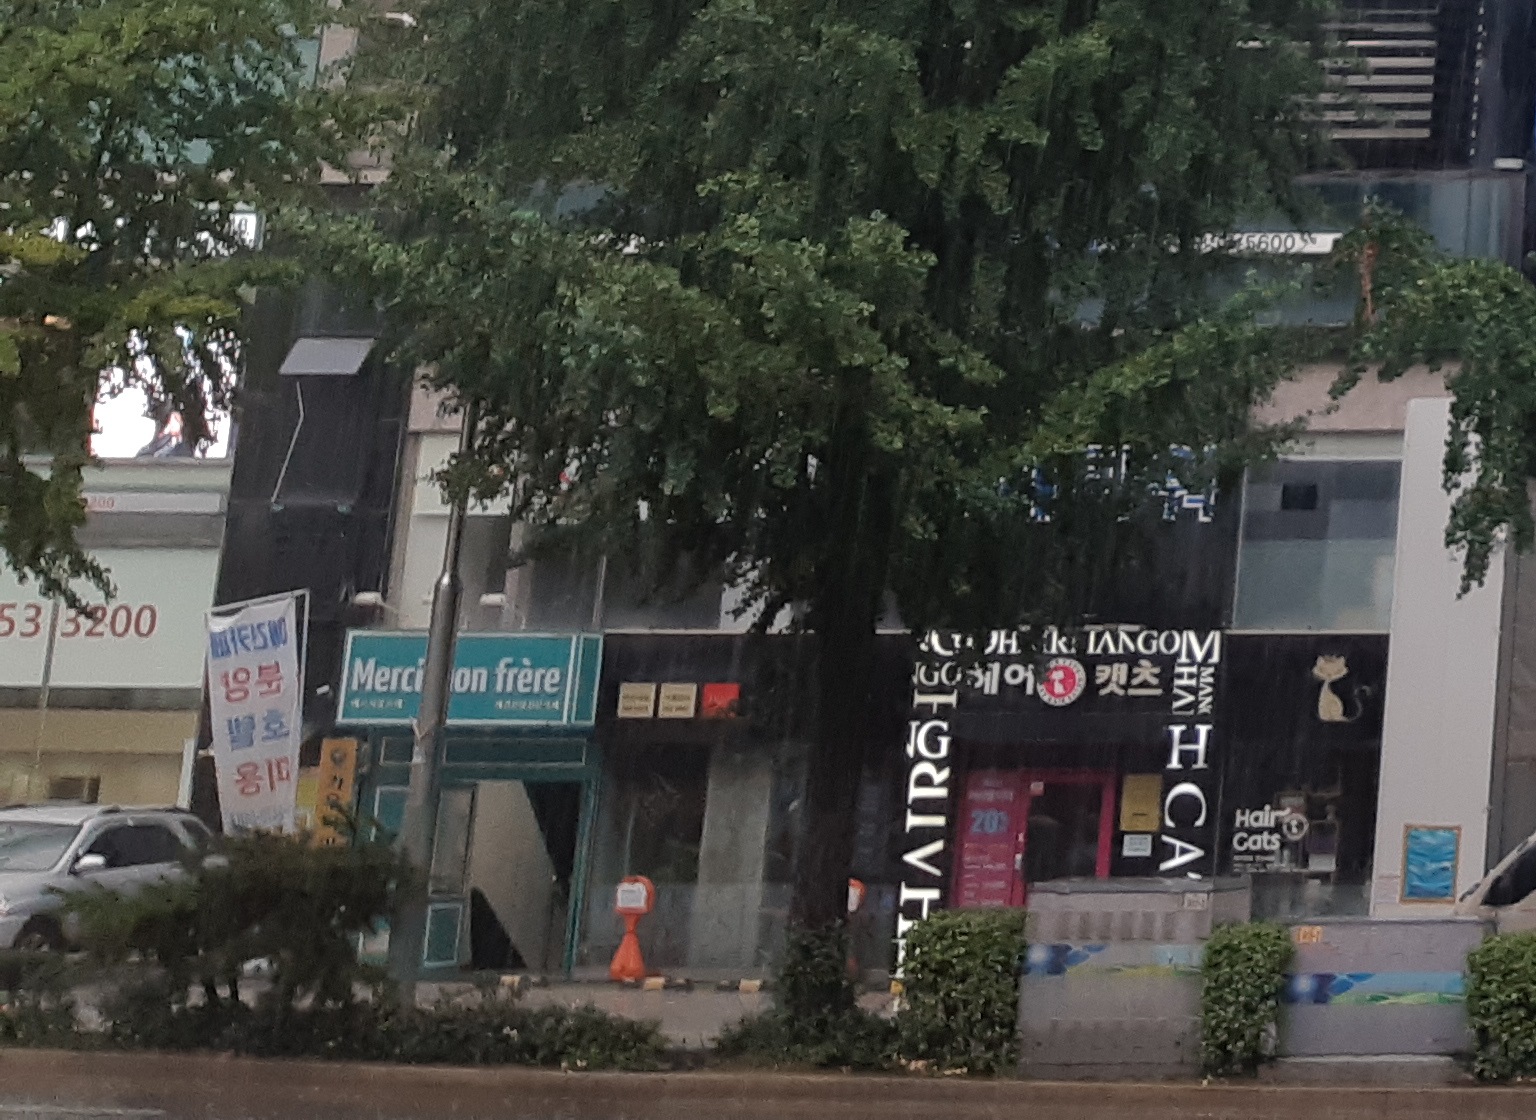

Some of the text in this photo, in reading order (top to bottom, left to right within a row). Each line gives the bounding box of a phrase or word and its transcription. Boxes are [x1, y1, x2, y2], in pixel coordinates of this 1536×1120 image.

[495, 657, 562, 694] frère
[1095, 659, 1164, 697] 캣츠
[1234, 803, 1292, 829] Hair
[1232, 830, 1281, 852] Cats
